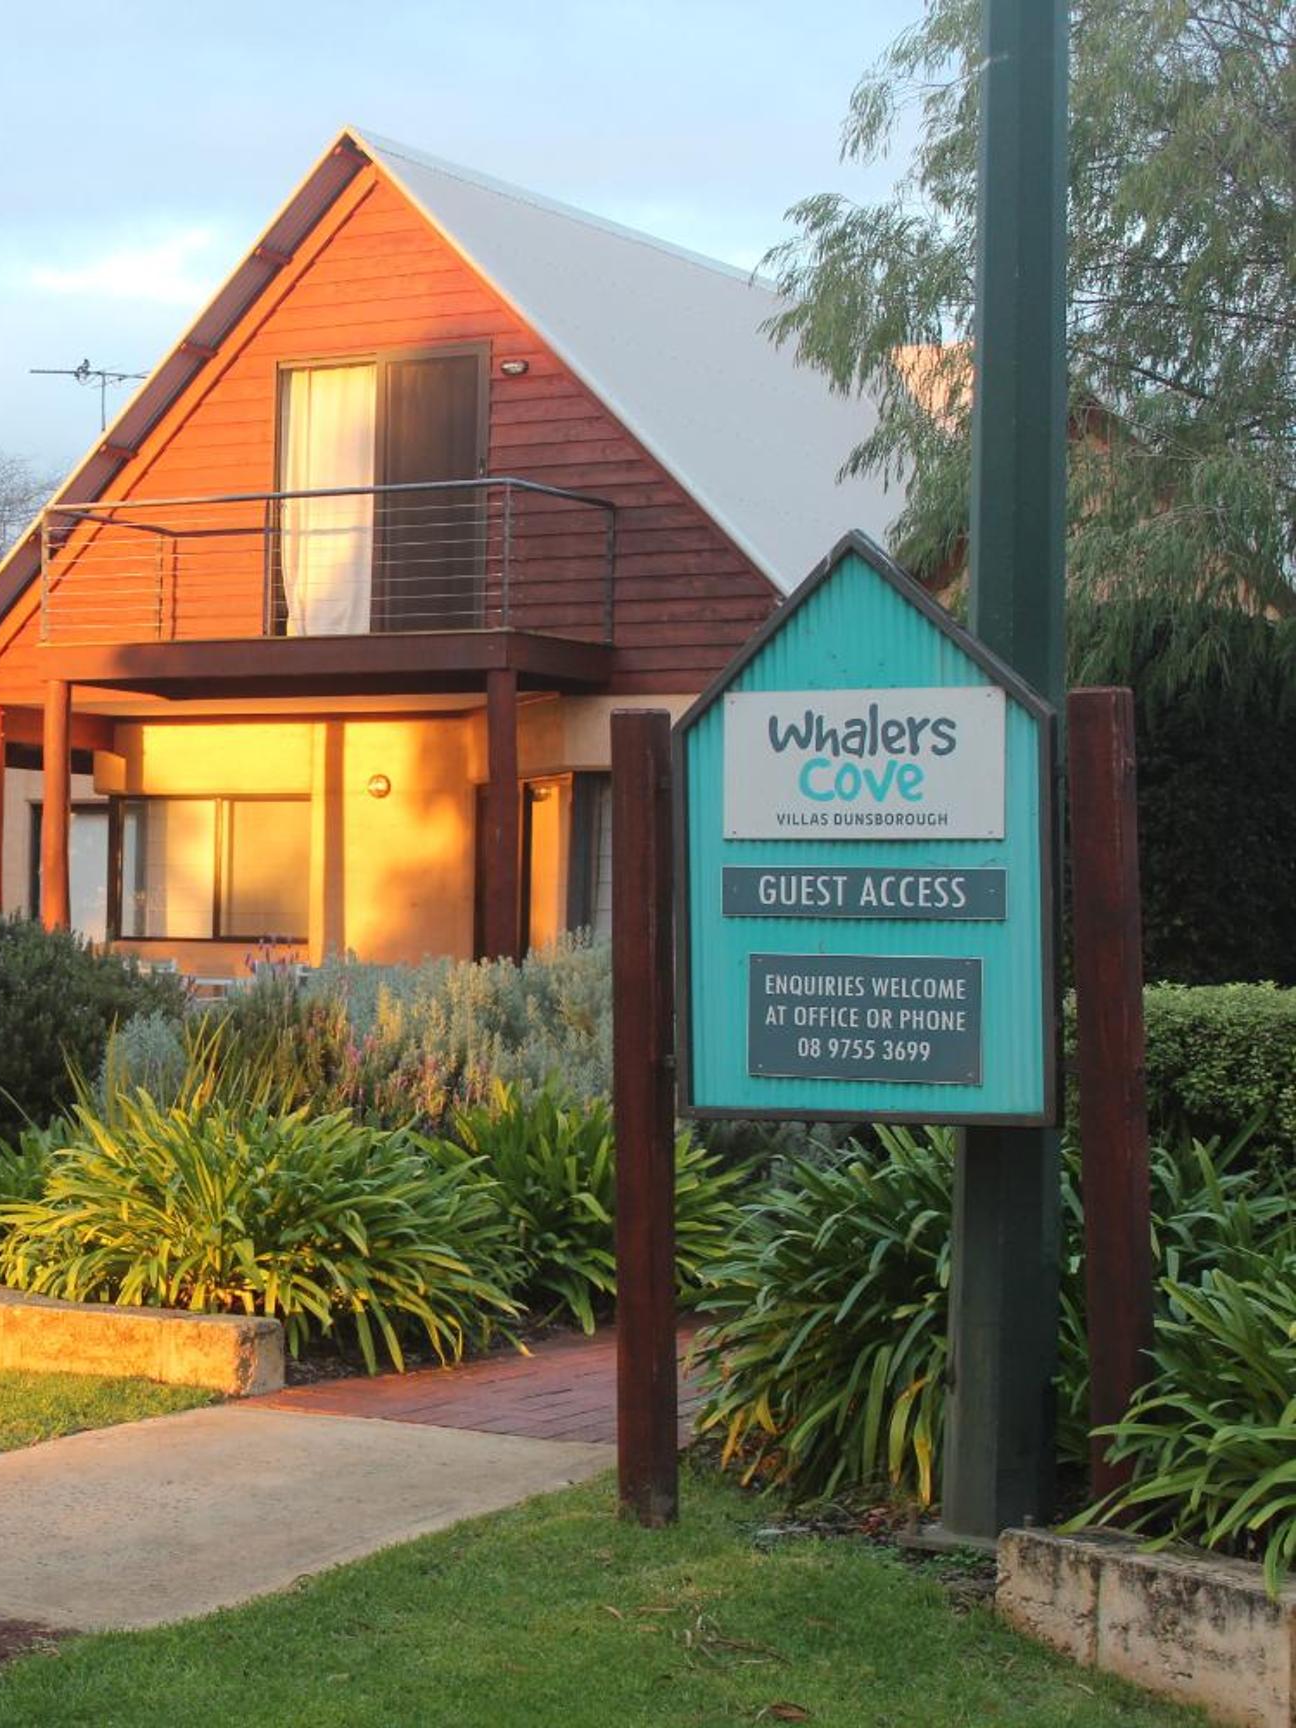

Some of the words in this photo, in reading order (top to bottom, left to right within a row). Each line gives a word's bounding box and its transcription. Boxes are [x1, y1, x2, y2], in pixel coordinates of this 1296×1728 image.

[798, 758, 924, 802] Cove
[776, 812, 829, 826] VILLAS
[833, 812, 948, 826] DUNSBOROUGH
[758, 874, 848, 907] GUEST
[859, 876, 966, 908] ACCESS
[765, 974, 865, 997] ENQUIRIES
[872, 977, 967, 1000] WELCOME
[765, 1005, 787, 1025] AT
[793, 1006, 859, 1028] OFFICE
[866, 1008, 892, 1030] OR
[899, 1010, 966, 1032] PHONE
[797, 1036, 821, 1058] 08
[828, 1037, 875, 1060] 9755
[882, 1039, 931, 1062] 3699
